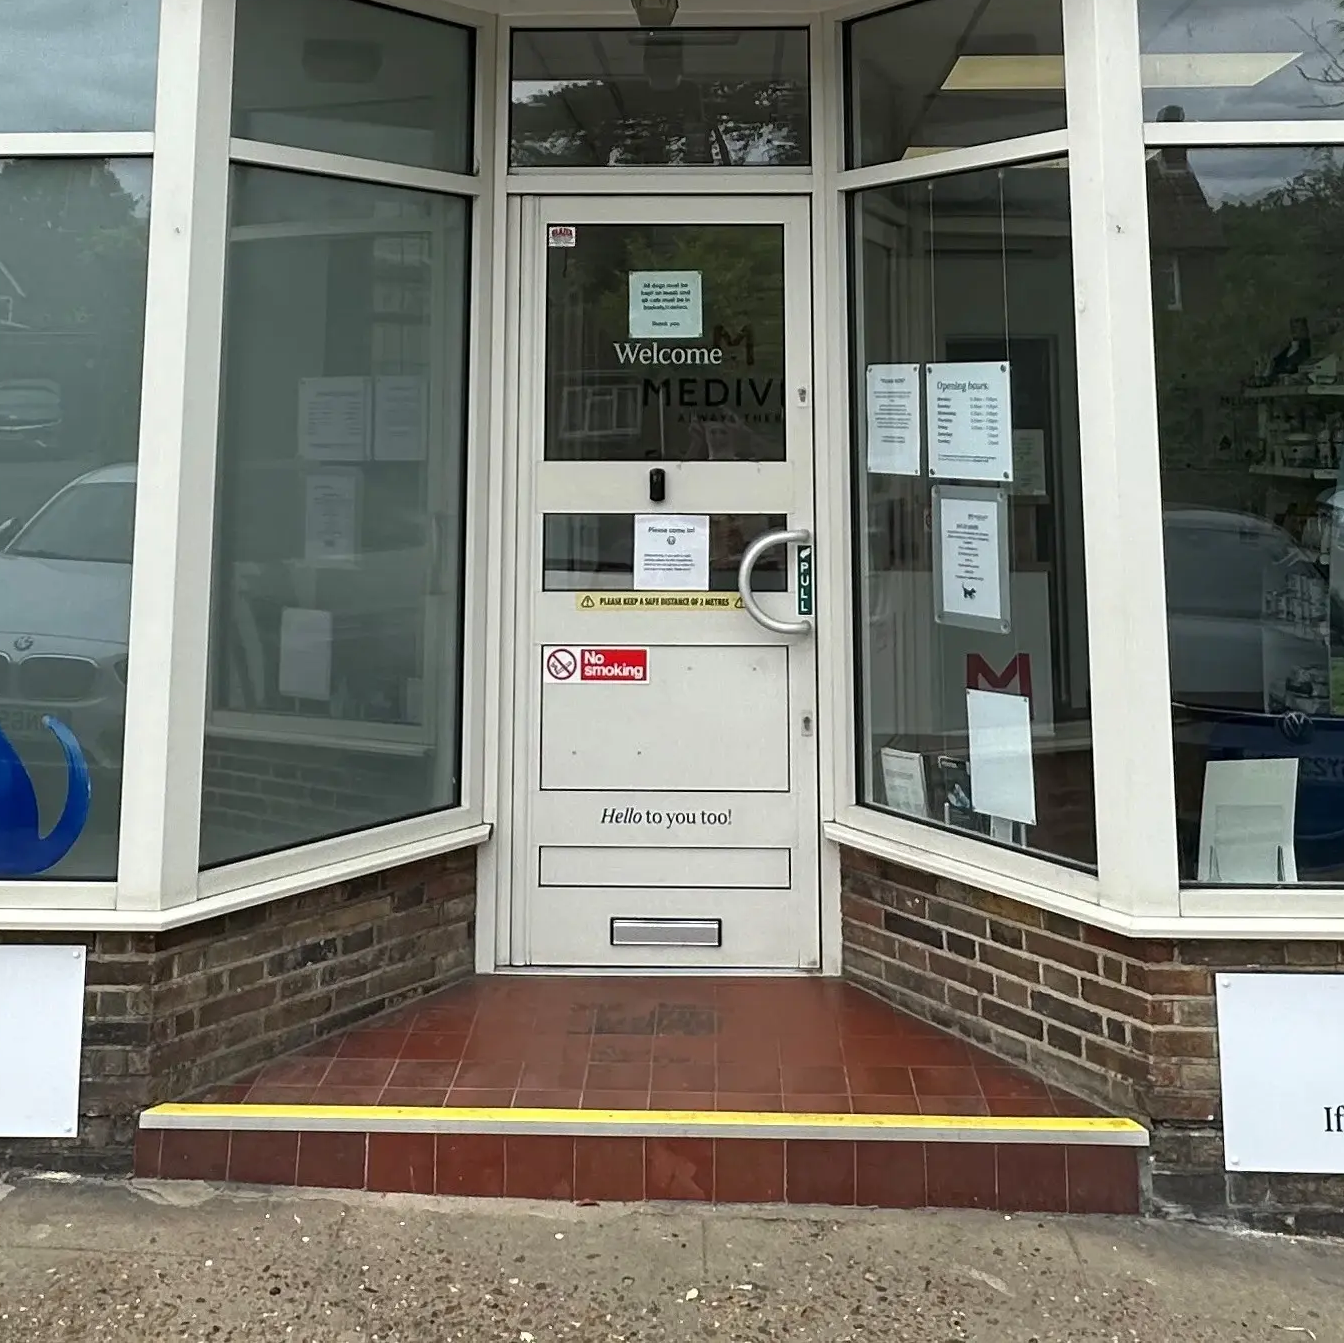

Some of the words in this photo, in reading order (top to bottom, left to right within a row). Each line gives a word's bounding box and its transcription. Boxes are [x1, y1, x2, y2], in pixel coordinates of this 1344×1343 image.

[612, 341, 723, 365] Welcome
[642, 378, 785, 407] MEDIV
[937, 381, 967, 392] Opening
[800, 561, 810, 612] PULL
[599, 598, 622, 606] PLEASE
[623, 598, 638, 606] KEEP
[639, 598, 644, 606] A
[645, 598, 659, 606] SAFE
[660, 598, 690, 606] DISTANCE
[690, 598, 699, 606] OF
[699, 598, 704, 606] 2
[705, 598, 730, 606] METRES
[584, 651, 605, 664] No
[584, 662, 644, 679] smoking
[600, 808, 643, 825] Hello
[645, 809, 663, 825] to
[666, 813, 697, 829] you
[700, 809, 732, 825] too!
